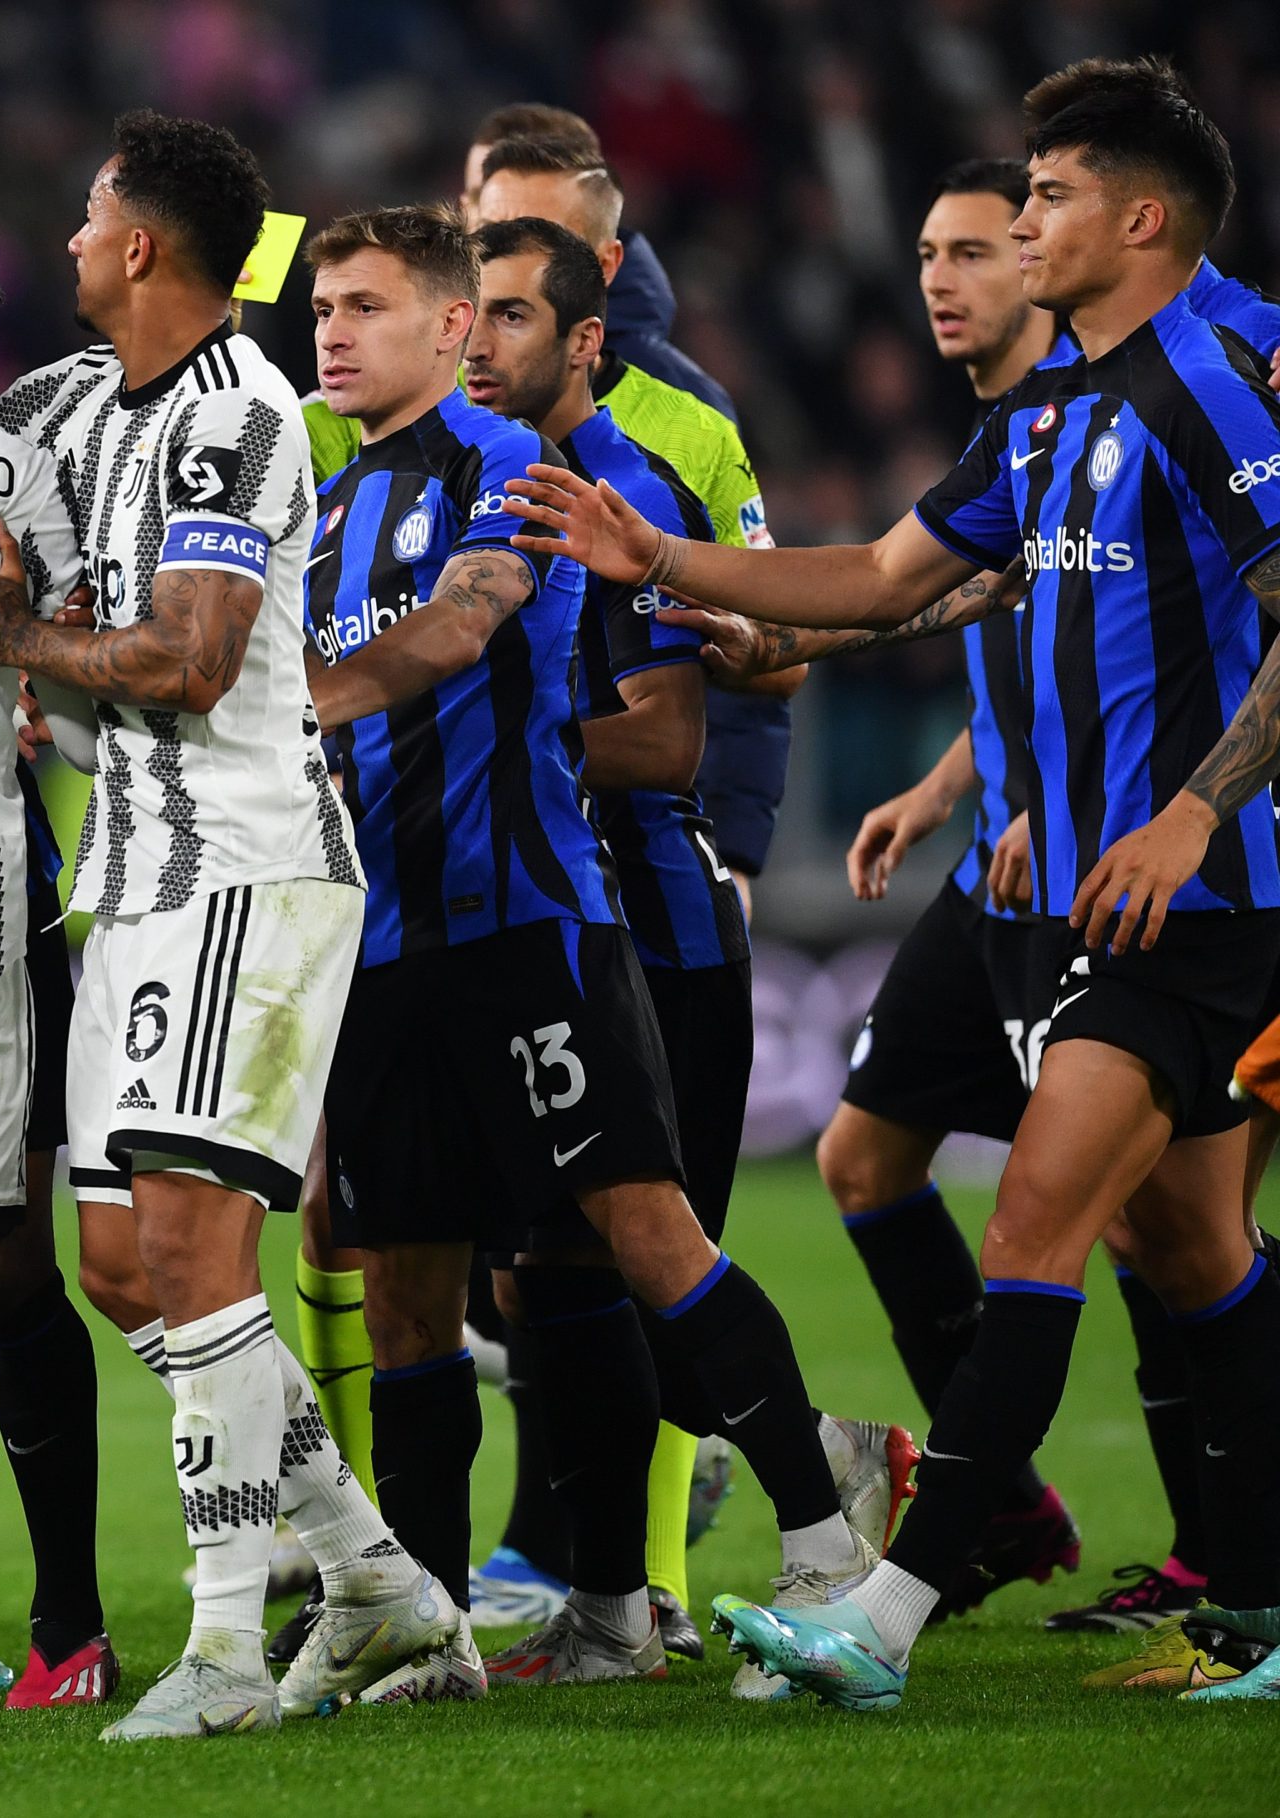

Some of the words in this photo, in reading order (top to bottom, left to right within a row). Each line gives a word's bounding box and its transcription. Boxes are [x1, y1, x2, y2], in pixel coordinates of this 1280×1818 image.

[183, 531, 266, 566] PEACE
[125, 980, 172, 1063] 6
[510, 1020, 586, 1118] 23
[116, 1097, 157, 1111] adidas
